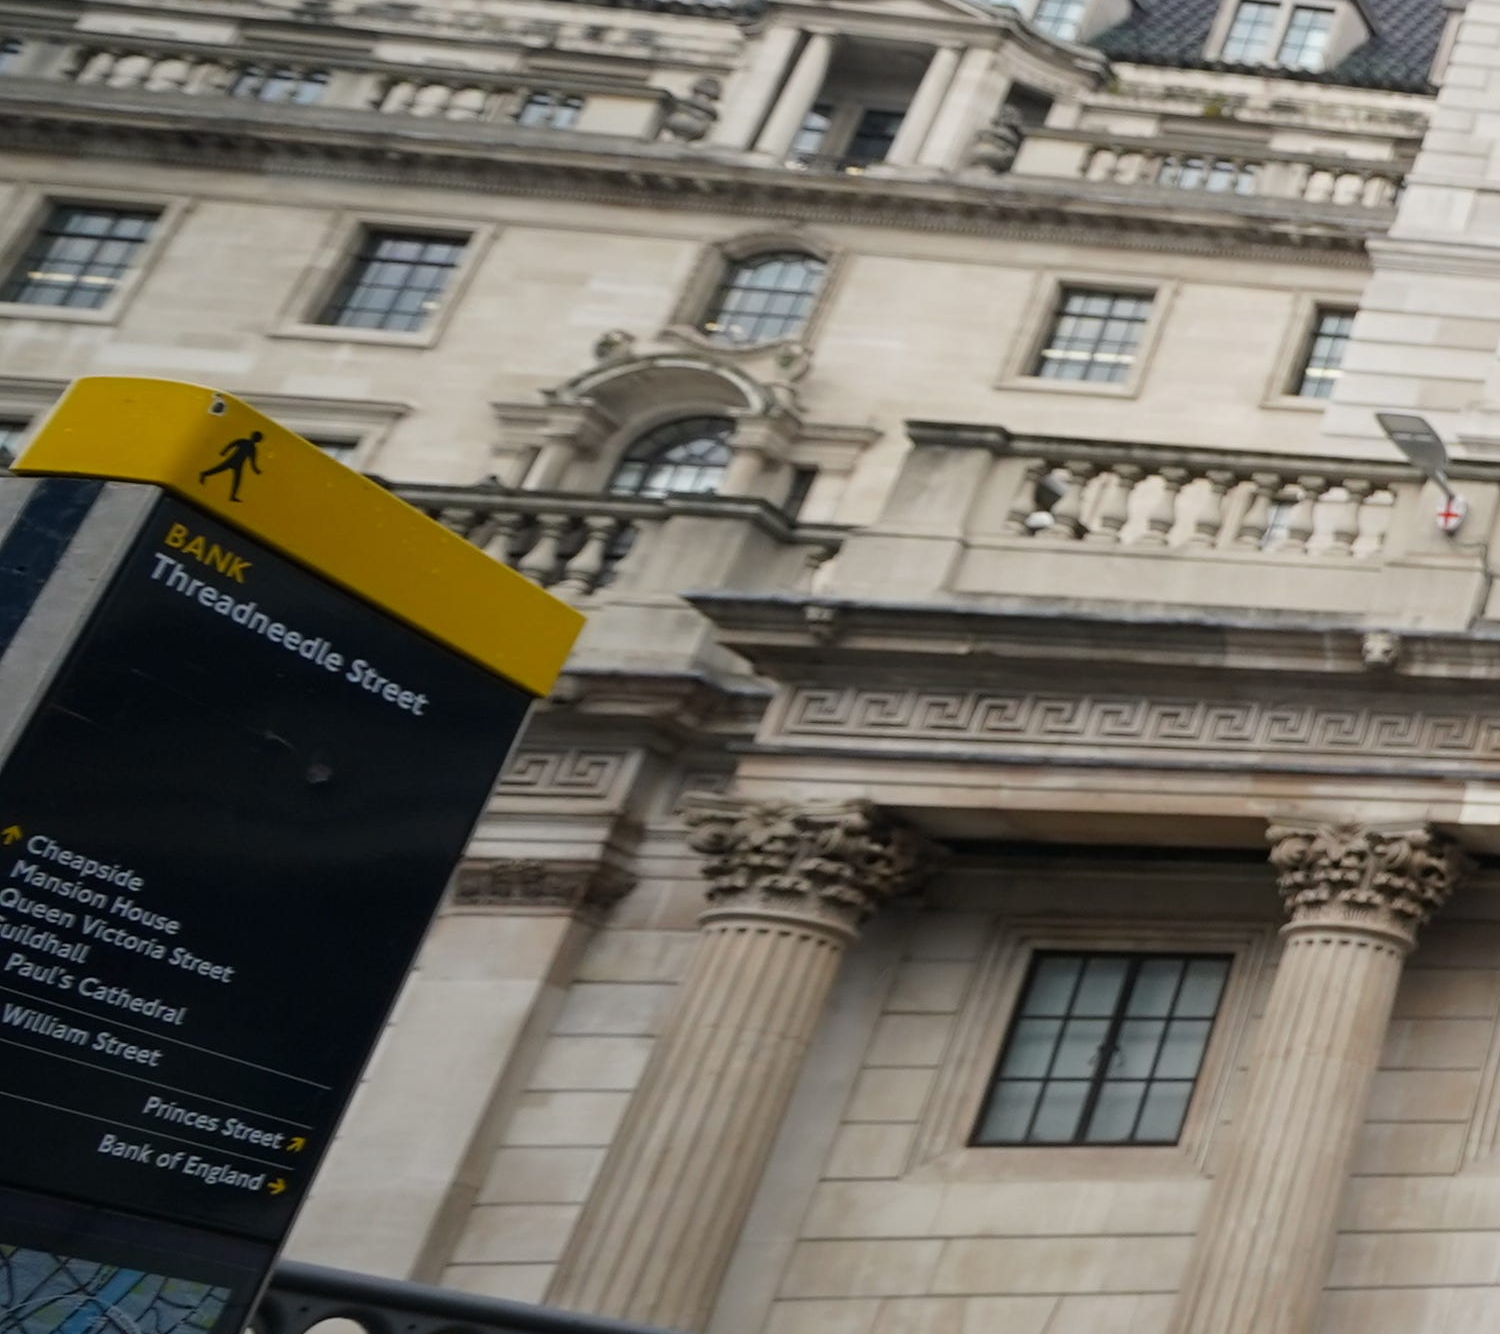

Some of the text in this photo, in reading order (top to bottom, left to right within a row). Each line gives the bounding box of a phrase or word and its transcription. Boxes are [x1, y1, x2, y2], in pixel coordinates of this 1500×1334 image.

[164, 523, 252, 584] BANK
[150, 552, 430, 716] Threadneedle Street
[26, 834, 146, 892] Cheapside
[10, 859, 182, 935] Mansion House
[0, 887, 236, 983] Queen Victoria Street
[0, 915, 91, 964] uildhall
[78, 977, 189, 1026] Cathedral
[2, 1002, 164, 1067] William Street
[141, 1095, 285, 1150] Princes Street
[97, 1133, 267, 1191] Bank of England
